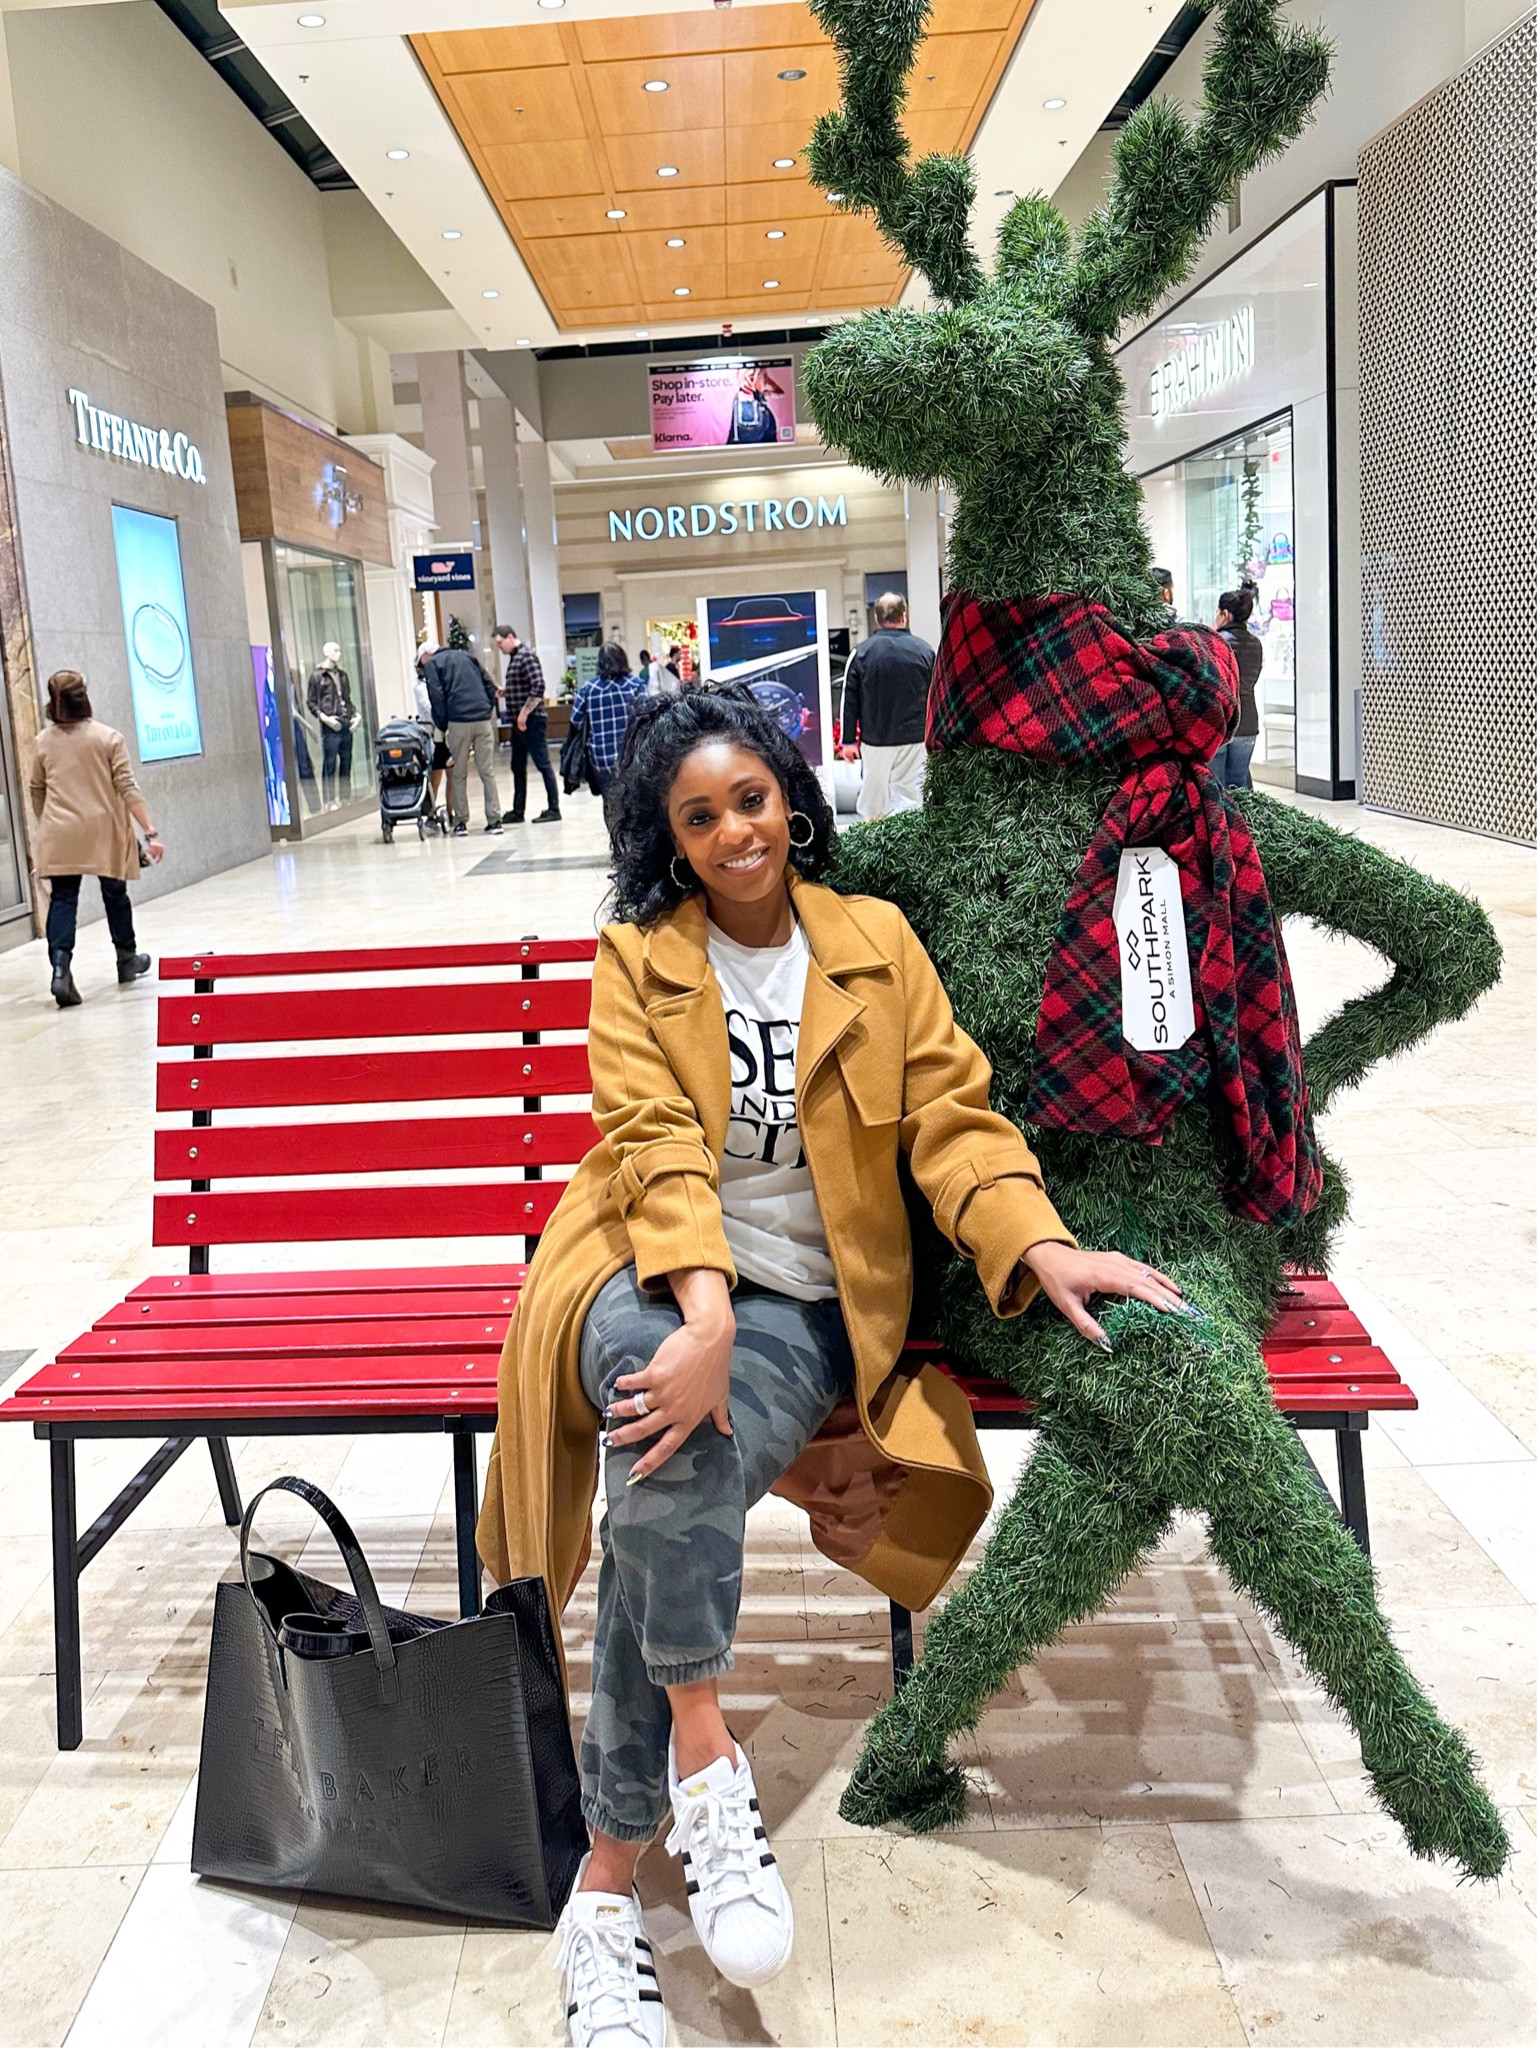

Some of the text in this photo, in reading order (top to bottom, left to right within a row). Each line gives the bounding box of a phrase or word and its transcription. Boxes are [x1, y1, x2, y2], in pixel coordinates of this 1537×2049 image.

[652, 377, 733, 391] Shop in-store.
[653, 392, 705, 406] Pay later.
[654, 432, 692, 443] Klarna.
[608, 494, 847, 543] NORDSTROM
[417, 572, 471, 584] vineyard vines
[1135, 856, 1168, 1043] SOUTHPARK
[1160, 899, 1176, 998] A SIMON MALL
[725, 1009, 800, 1096] SE
[730, 1093, 795, 1120] ND
[321, 1746, 474, 1800] BAKER
